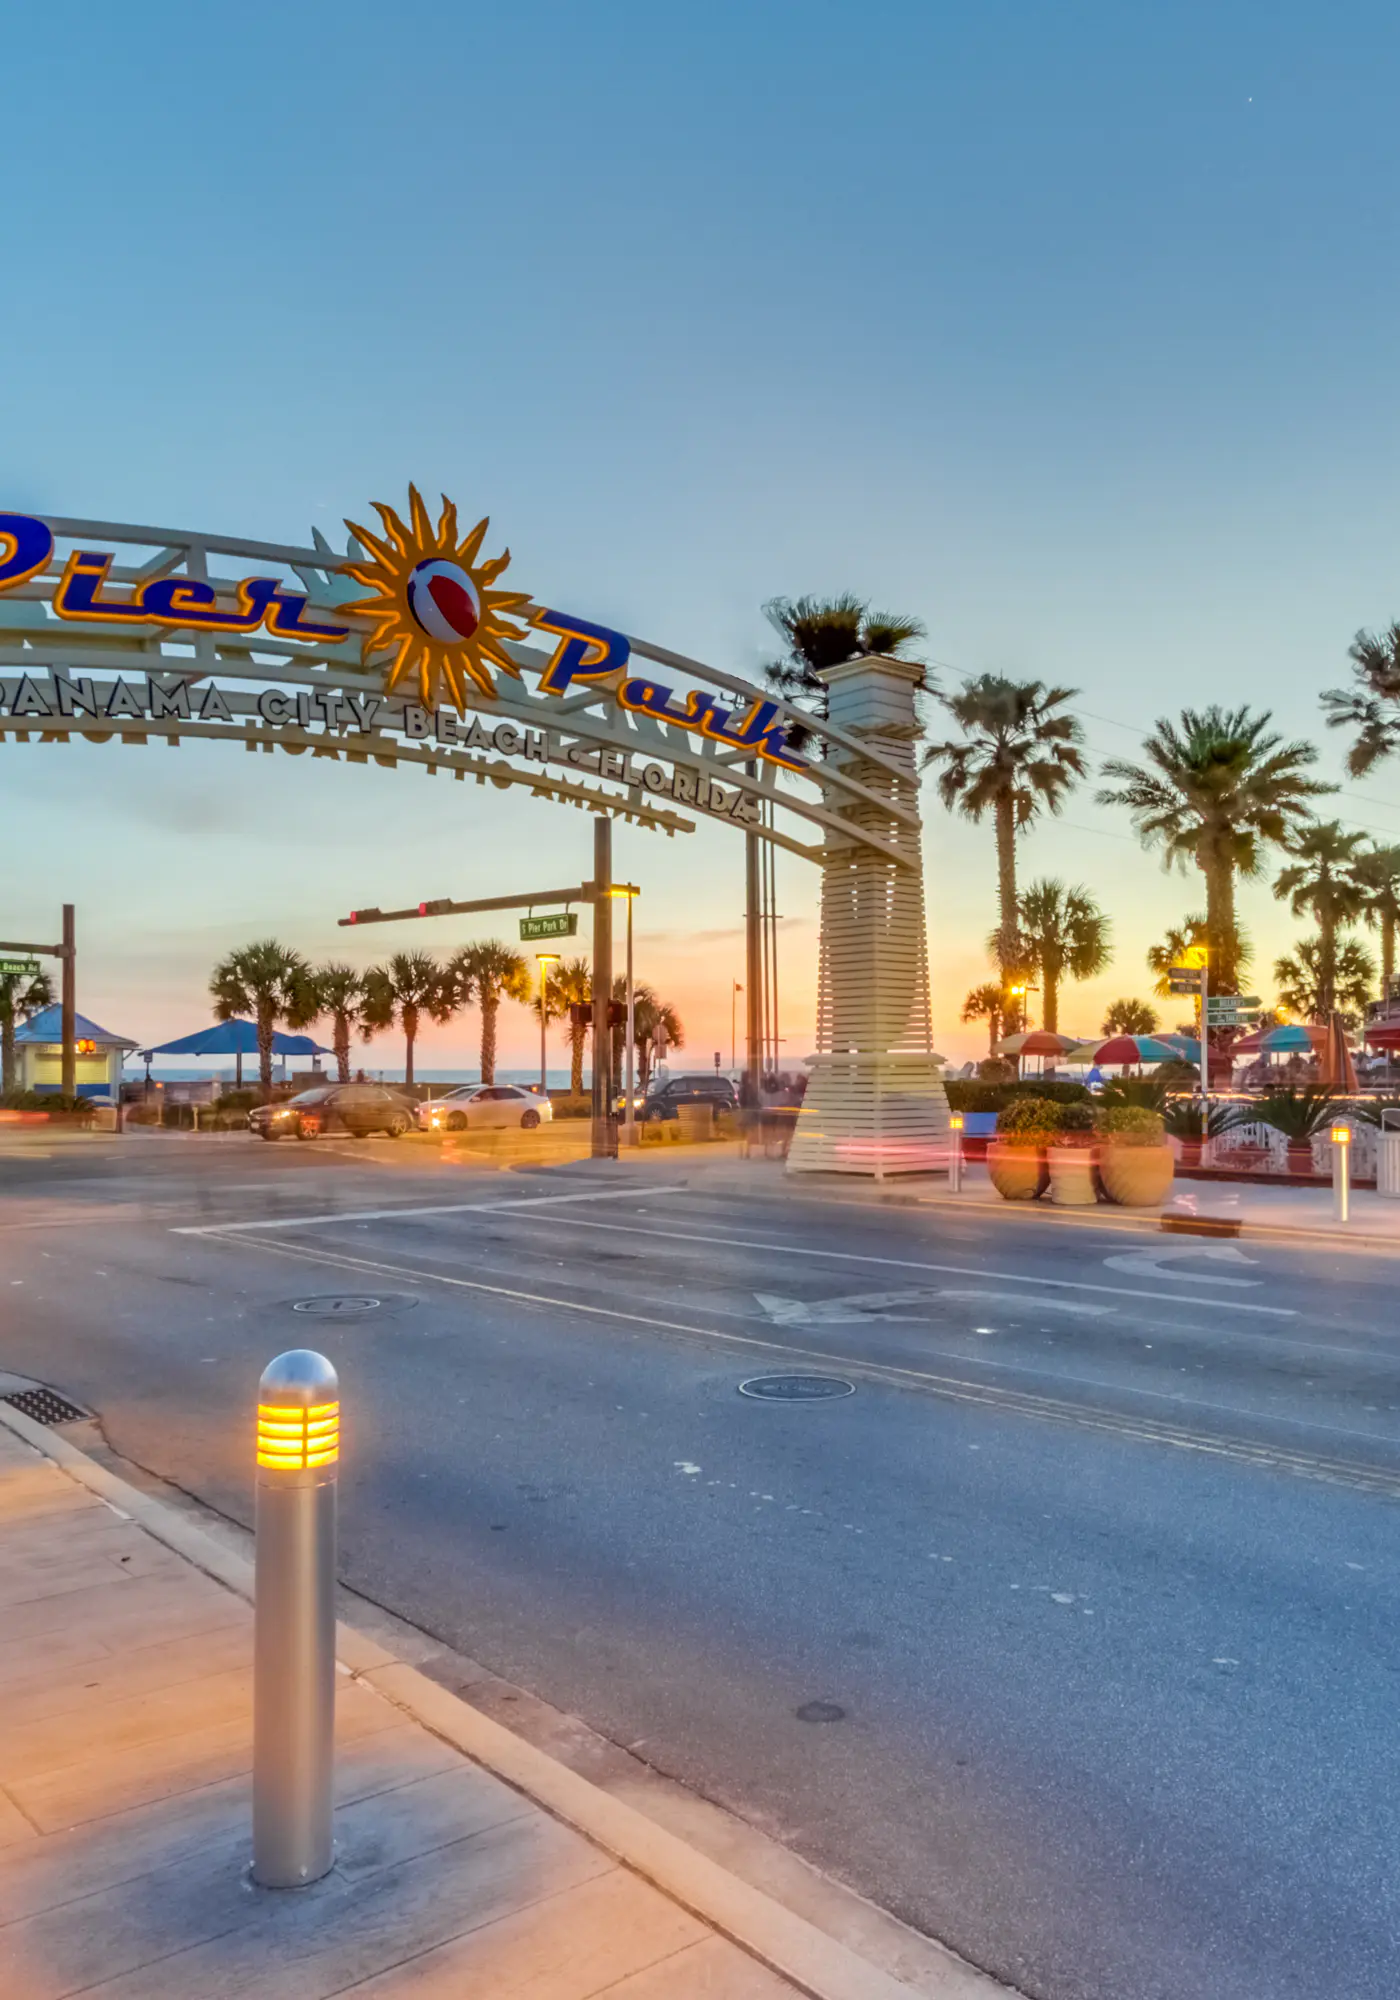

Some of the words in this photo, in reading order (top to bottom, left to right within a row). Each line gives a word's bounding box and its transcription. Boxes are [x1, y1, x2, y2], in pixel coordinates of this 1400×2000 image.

[0, 671, 233, 722] ANAMA
[257, 688, 380, 733] CITY
[403, 705, 550, 763] BEACH
[599, 748, 762, 823] FLORIDA
[526, 606, 811, 772] Park
[521, 923, 526, 935] S
[528, 921, 541, 934] Pier
[542, 919, 557, 932] Park
[559, 918, 567, 930] Dr
